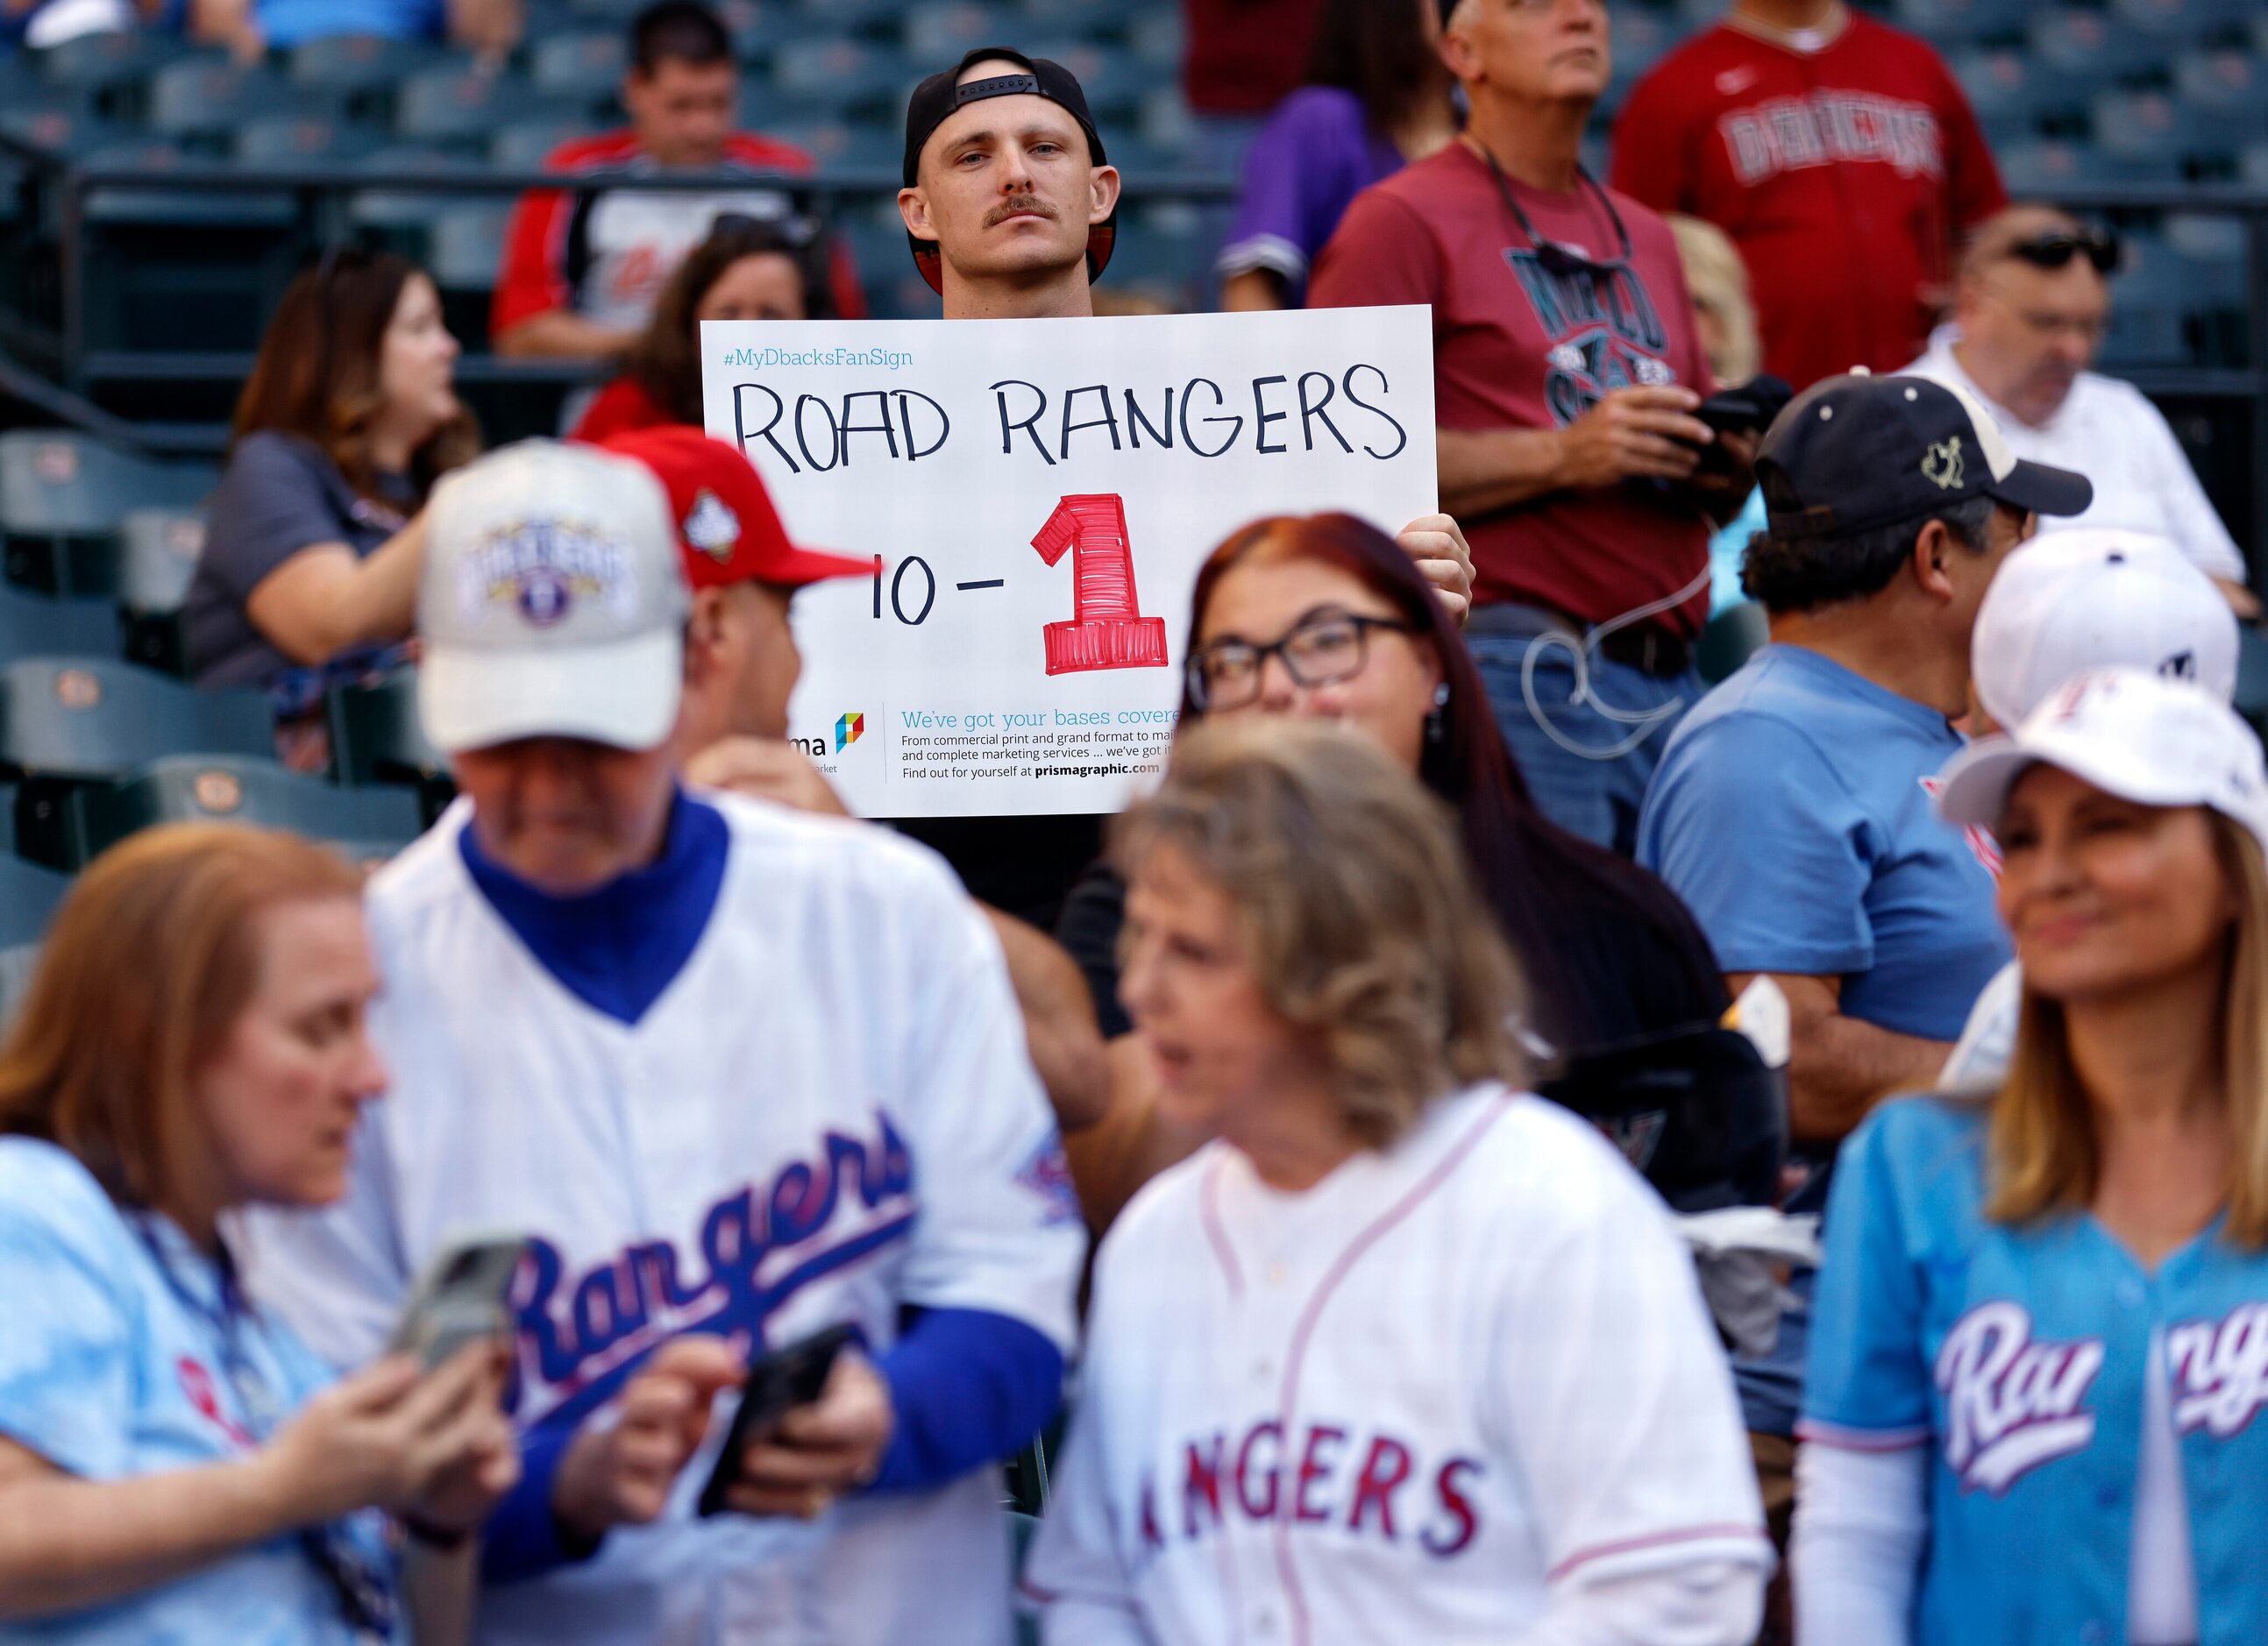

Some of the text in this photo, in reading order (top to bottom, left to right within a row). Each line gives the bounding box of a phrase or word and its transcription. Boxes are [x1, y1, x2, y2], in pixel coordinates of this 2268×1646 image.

[723, 347, 914, 370] #MyDbacksFanSign
[733, 364, 1407, 474] ROAD RANGERS
[1030, 493, 1170, 677] 1
[900, 711, 958, 729] We've
[963, 710, 996, 732] got
[1001, 713, 1048, 731] your
[1053, 707, 1111, 726] bases
[901, 728, 1177, 747] From commercial print and grand format to mai
[901, 749, 923, 762] and
[926, 749, 979, 763] complete
[982, 747, 1040, 762] marketing
[1042, 746, 1090, 758] services
[1106, 744, 1140, 756] we've
[1142, 744, 1162, 757] got
[814, 763, 838, 773] arket
[903, 761, 1160, 779] Find out for yourself at prismagraphic.com
[1140, 1415, 1485, 1557] NGERS
